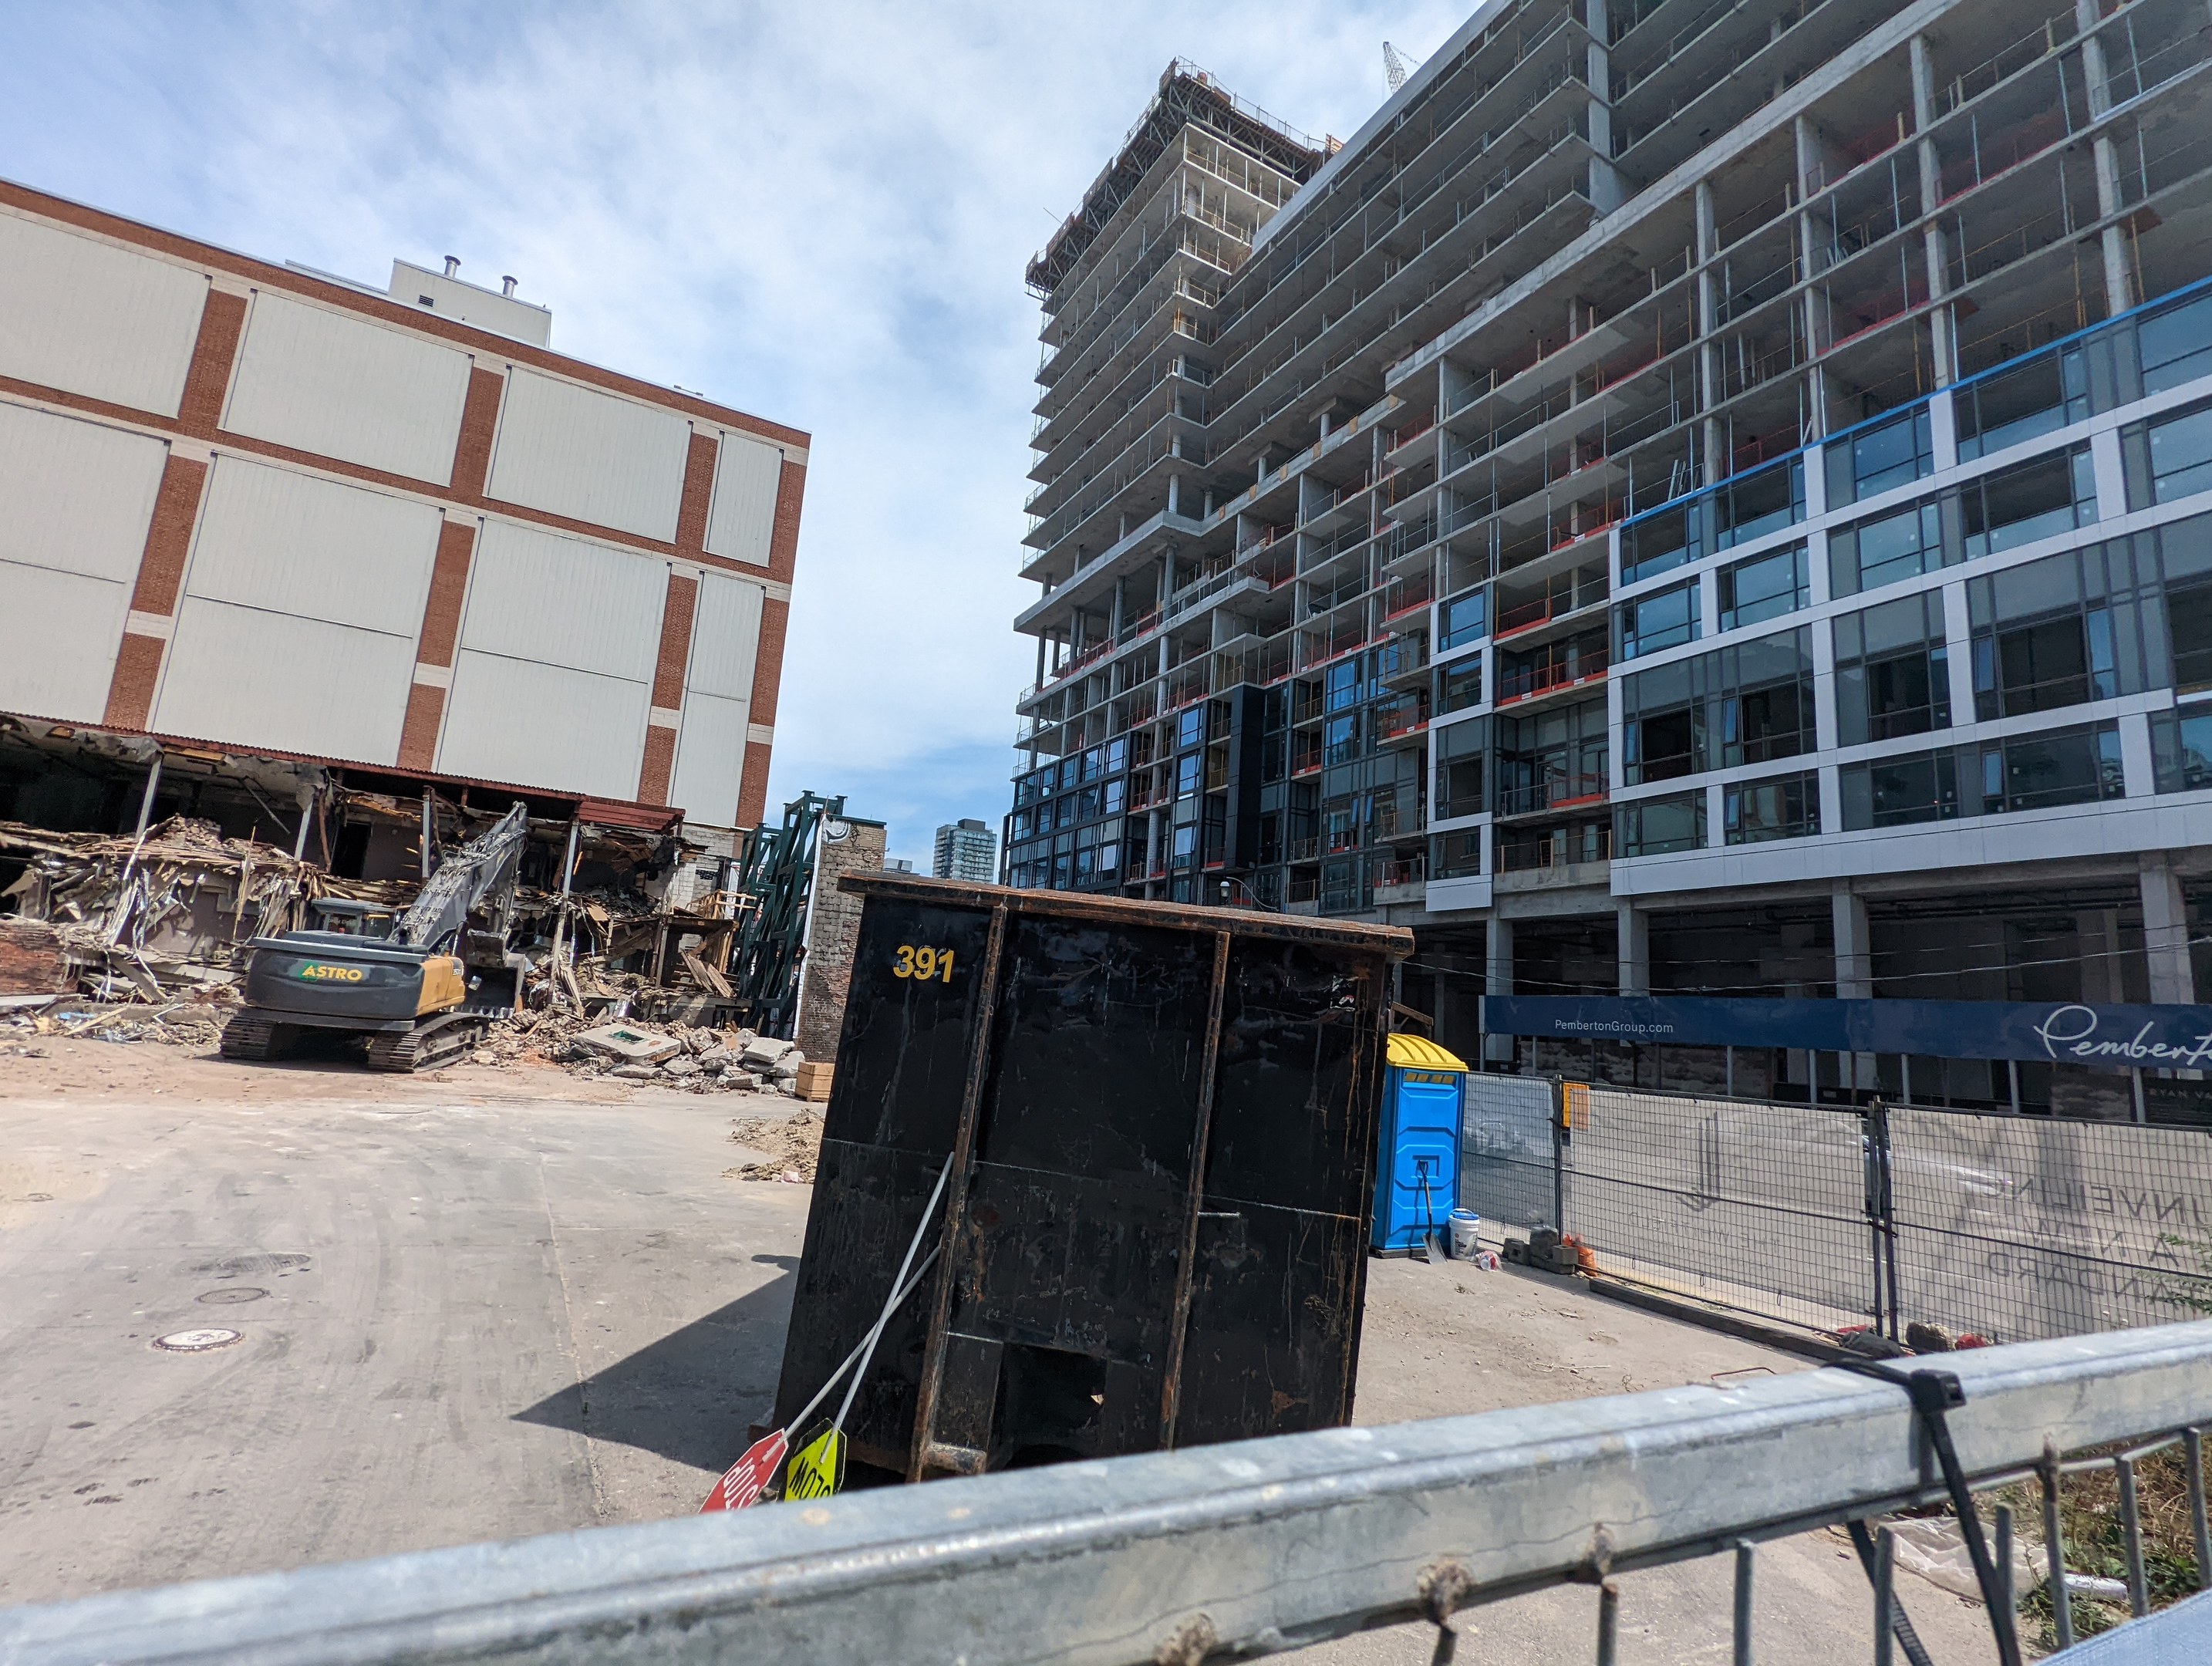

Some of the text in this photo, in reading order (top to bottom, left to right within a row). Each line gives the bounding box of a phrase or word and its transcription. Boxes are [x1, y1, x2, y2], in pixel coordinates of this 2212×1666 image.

[302, 964, 362, 981] ASTRO
[892, 945, 955, 983] 391
[1554, 1019, 1674, 1035] PembertonGroup.com
[2032, 1004, 2212, 1066] Pembert
[723, 1457, 759, 1510] STOP
